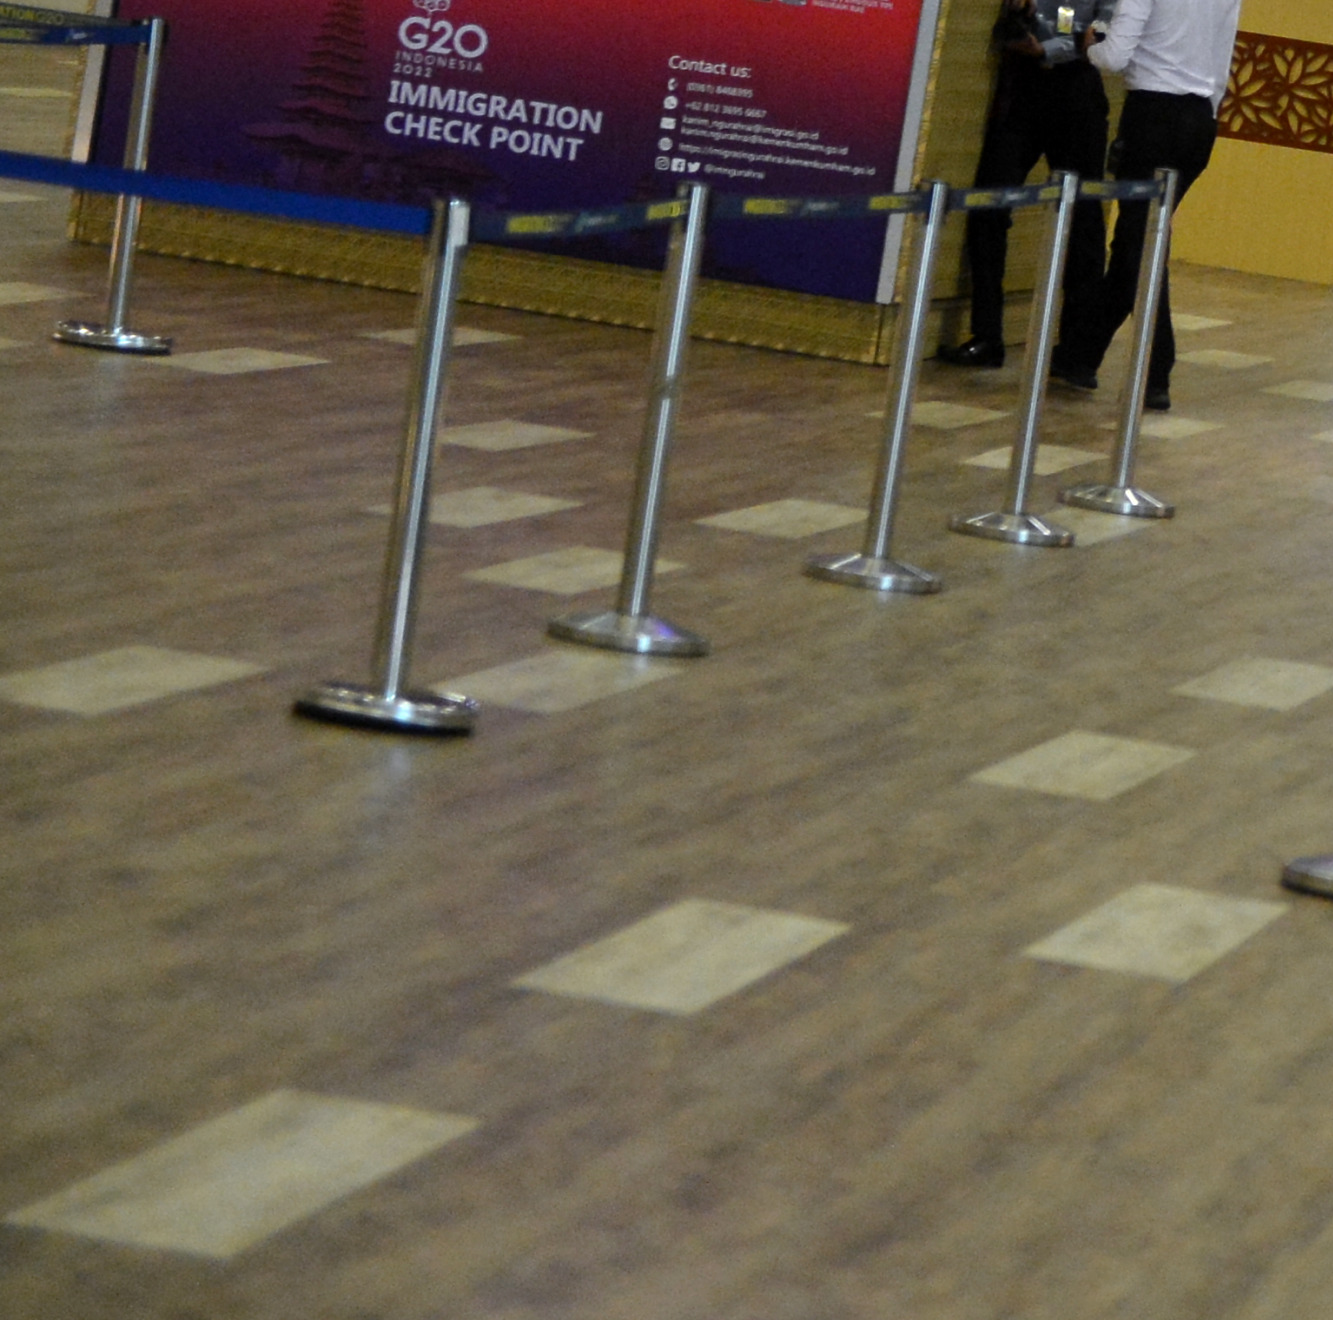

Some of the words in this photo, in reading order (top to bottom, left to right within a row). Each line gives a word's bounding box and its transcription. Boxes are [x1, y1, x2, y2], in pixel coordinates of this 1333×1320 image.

[398, 16, 488, 58] G20
[393, 63, 433, 78] 2022
[396, 50, 483, 72] INDONESIA
[668, 55, 729, 76] Contact
[730, 65, 752, 78] us:
[388, 80, 603, 134] IMMIGRATION
[384, 111, 482, 147] CHECK
[489, 126, 583, 161] POINT
